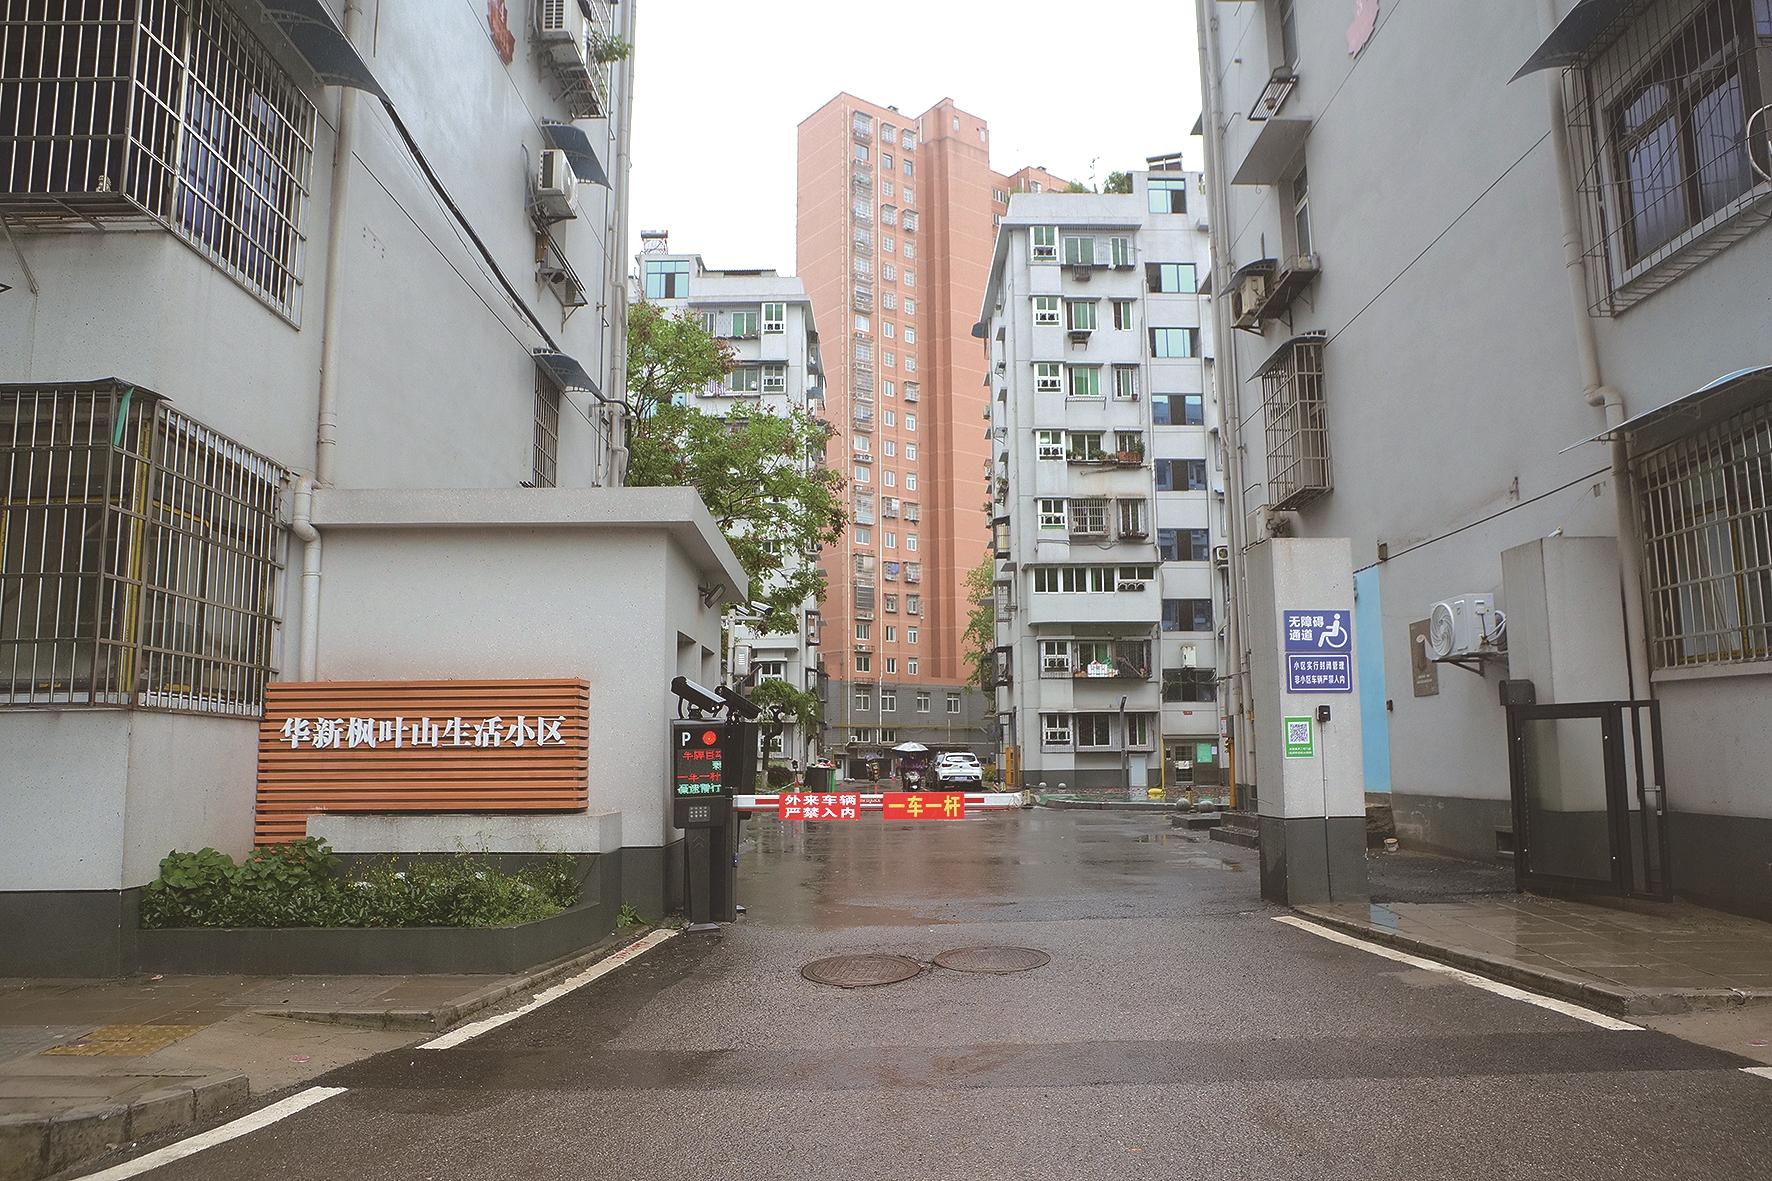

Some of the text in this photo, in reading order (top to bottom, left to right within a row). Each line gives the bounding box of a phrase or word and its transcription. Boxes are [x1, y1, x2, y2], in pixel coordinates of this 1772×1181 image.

[1289, 615, 1324, 628] 无障碍
[1289, 629, 1313, 641] 通道
[1294, 661, 1345, 671] 小区实行封闭管理
[279, 714, 567, 749] 华新枫叶山生活小区
[681, 731, 691, 747] P
[677, 772, 721, 782] 一车一杆
[784, 794, 857, 806] 外来车辆
[888, 795, 961, 818] 一车一杆
[784, 807, 856, 819] 严禁入内
